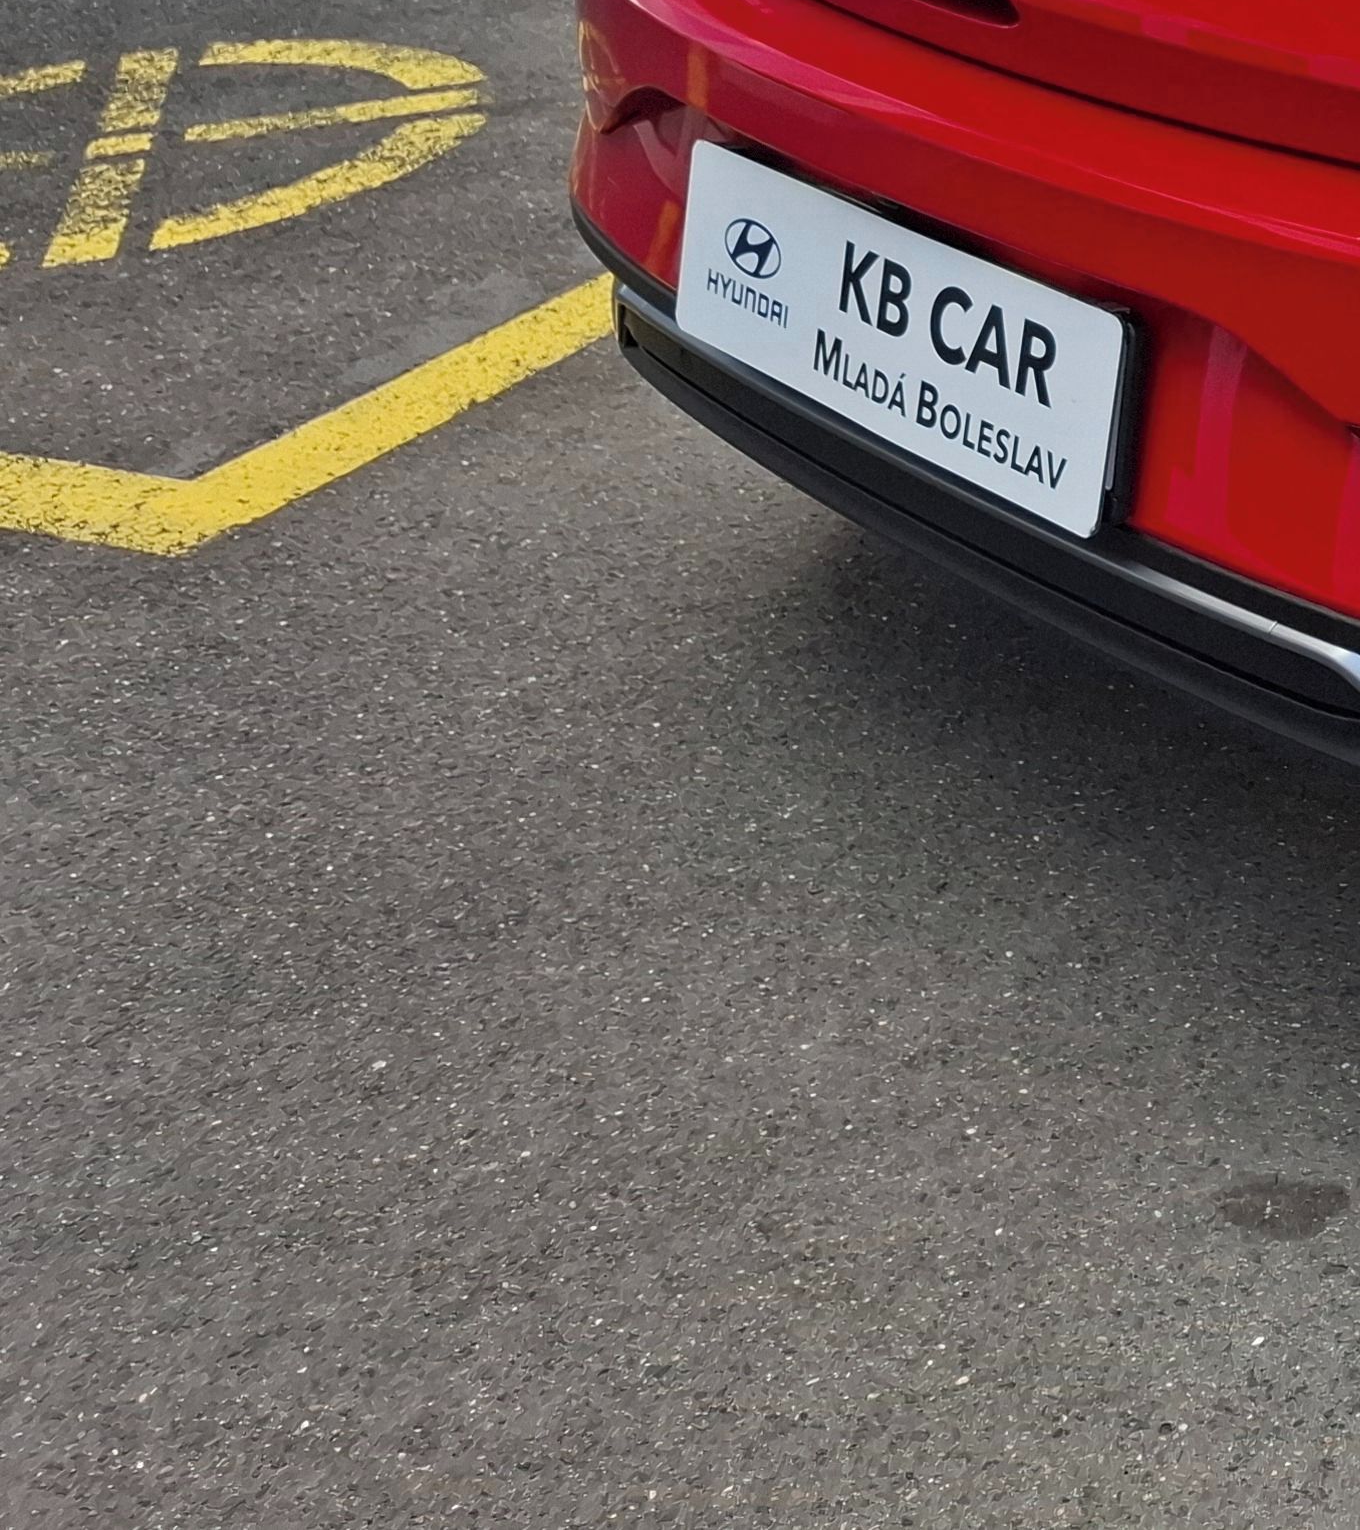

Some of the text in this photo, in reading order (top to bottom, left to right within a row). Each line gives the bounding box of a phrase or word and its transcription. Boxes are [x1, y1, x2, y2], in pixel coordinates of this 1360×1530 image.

[706, 268, 789, 329] HYUNDAI
[838, 240, 1057, 409] KB CAR
